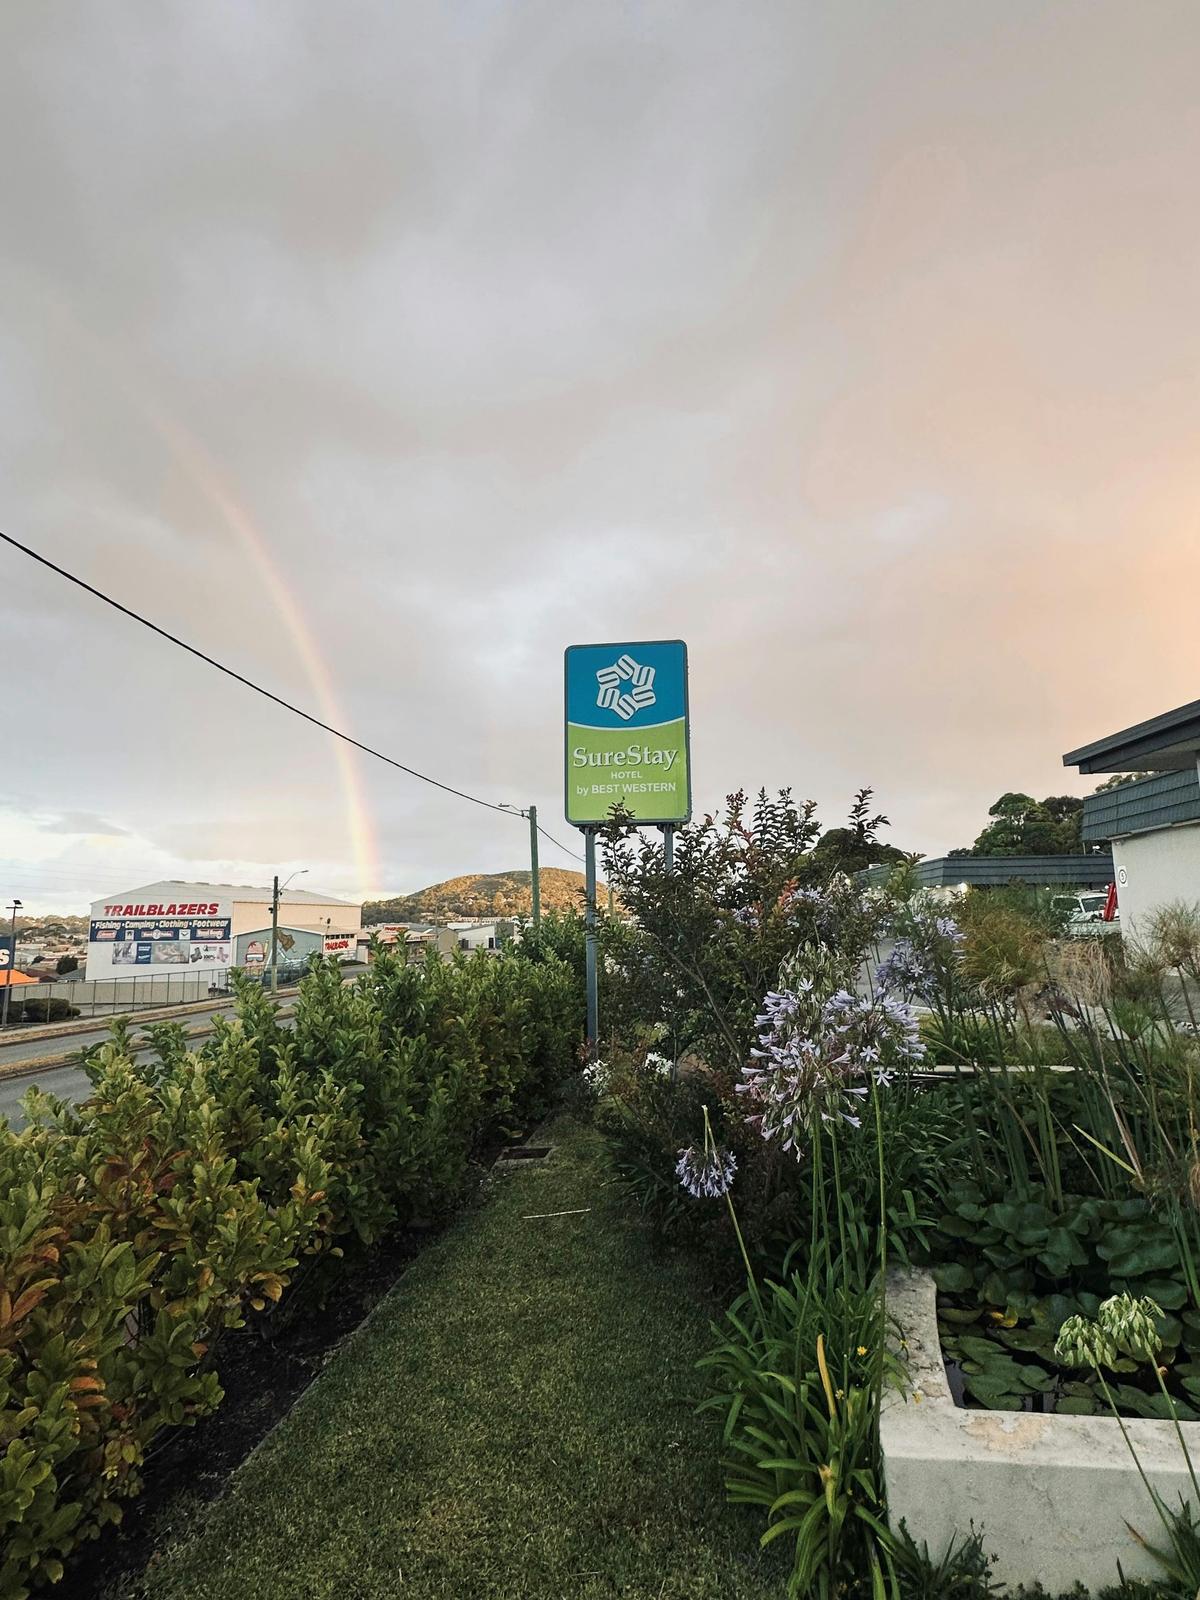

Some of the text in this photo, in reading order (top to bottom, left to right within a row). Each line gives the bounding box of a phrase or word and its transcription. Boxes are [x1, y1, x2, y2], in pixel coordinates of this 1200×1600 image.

[573, 744, 679, 771] SureStay
[611, 771, 643, 779] HOTEL
[576, 782, 676, 796] by BEST WESTERN
[104, 903, 219, 916] TRAILBLAZERS
[95, 919, 228, 930] Fishing Camping Clothing Footwear
